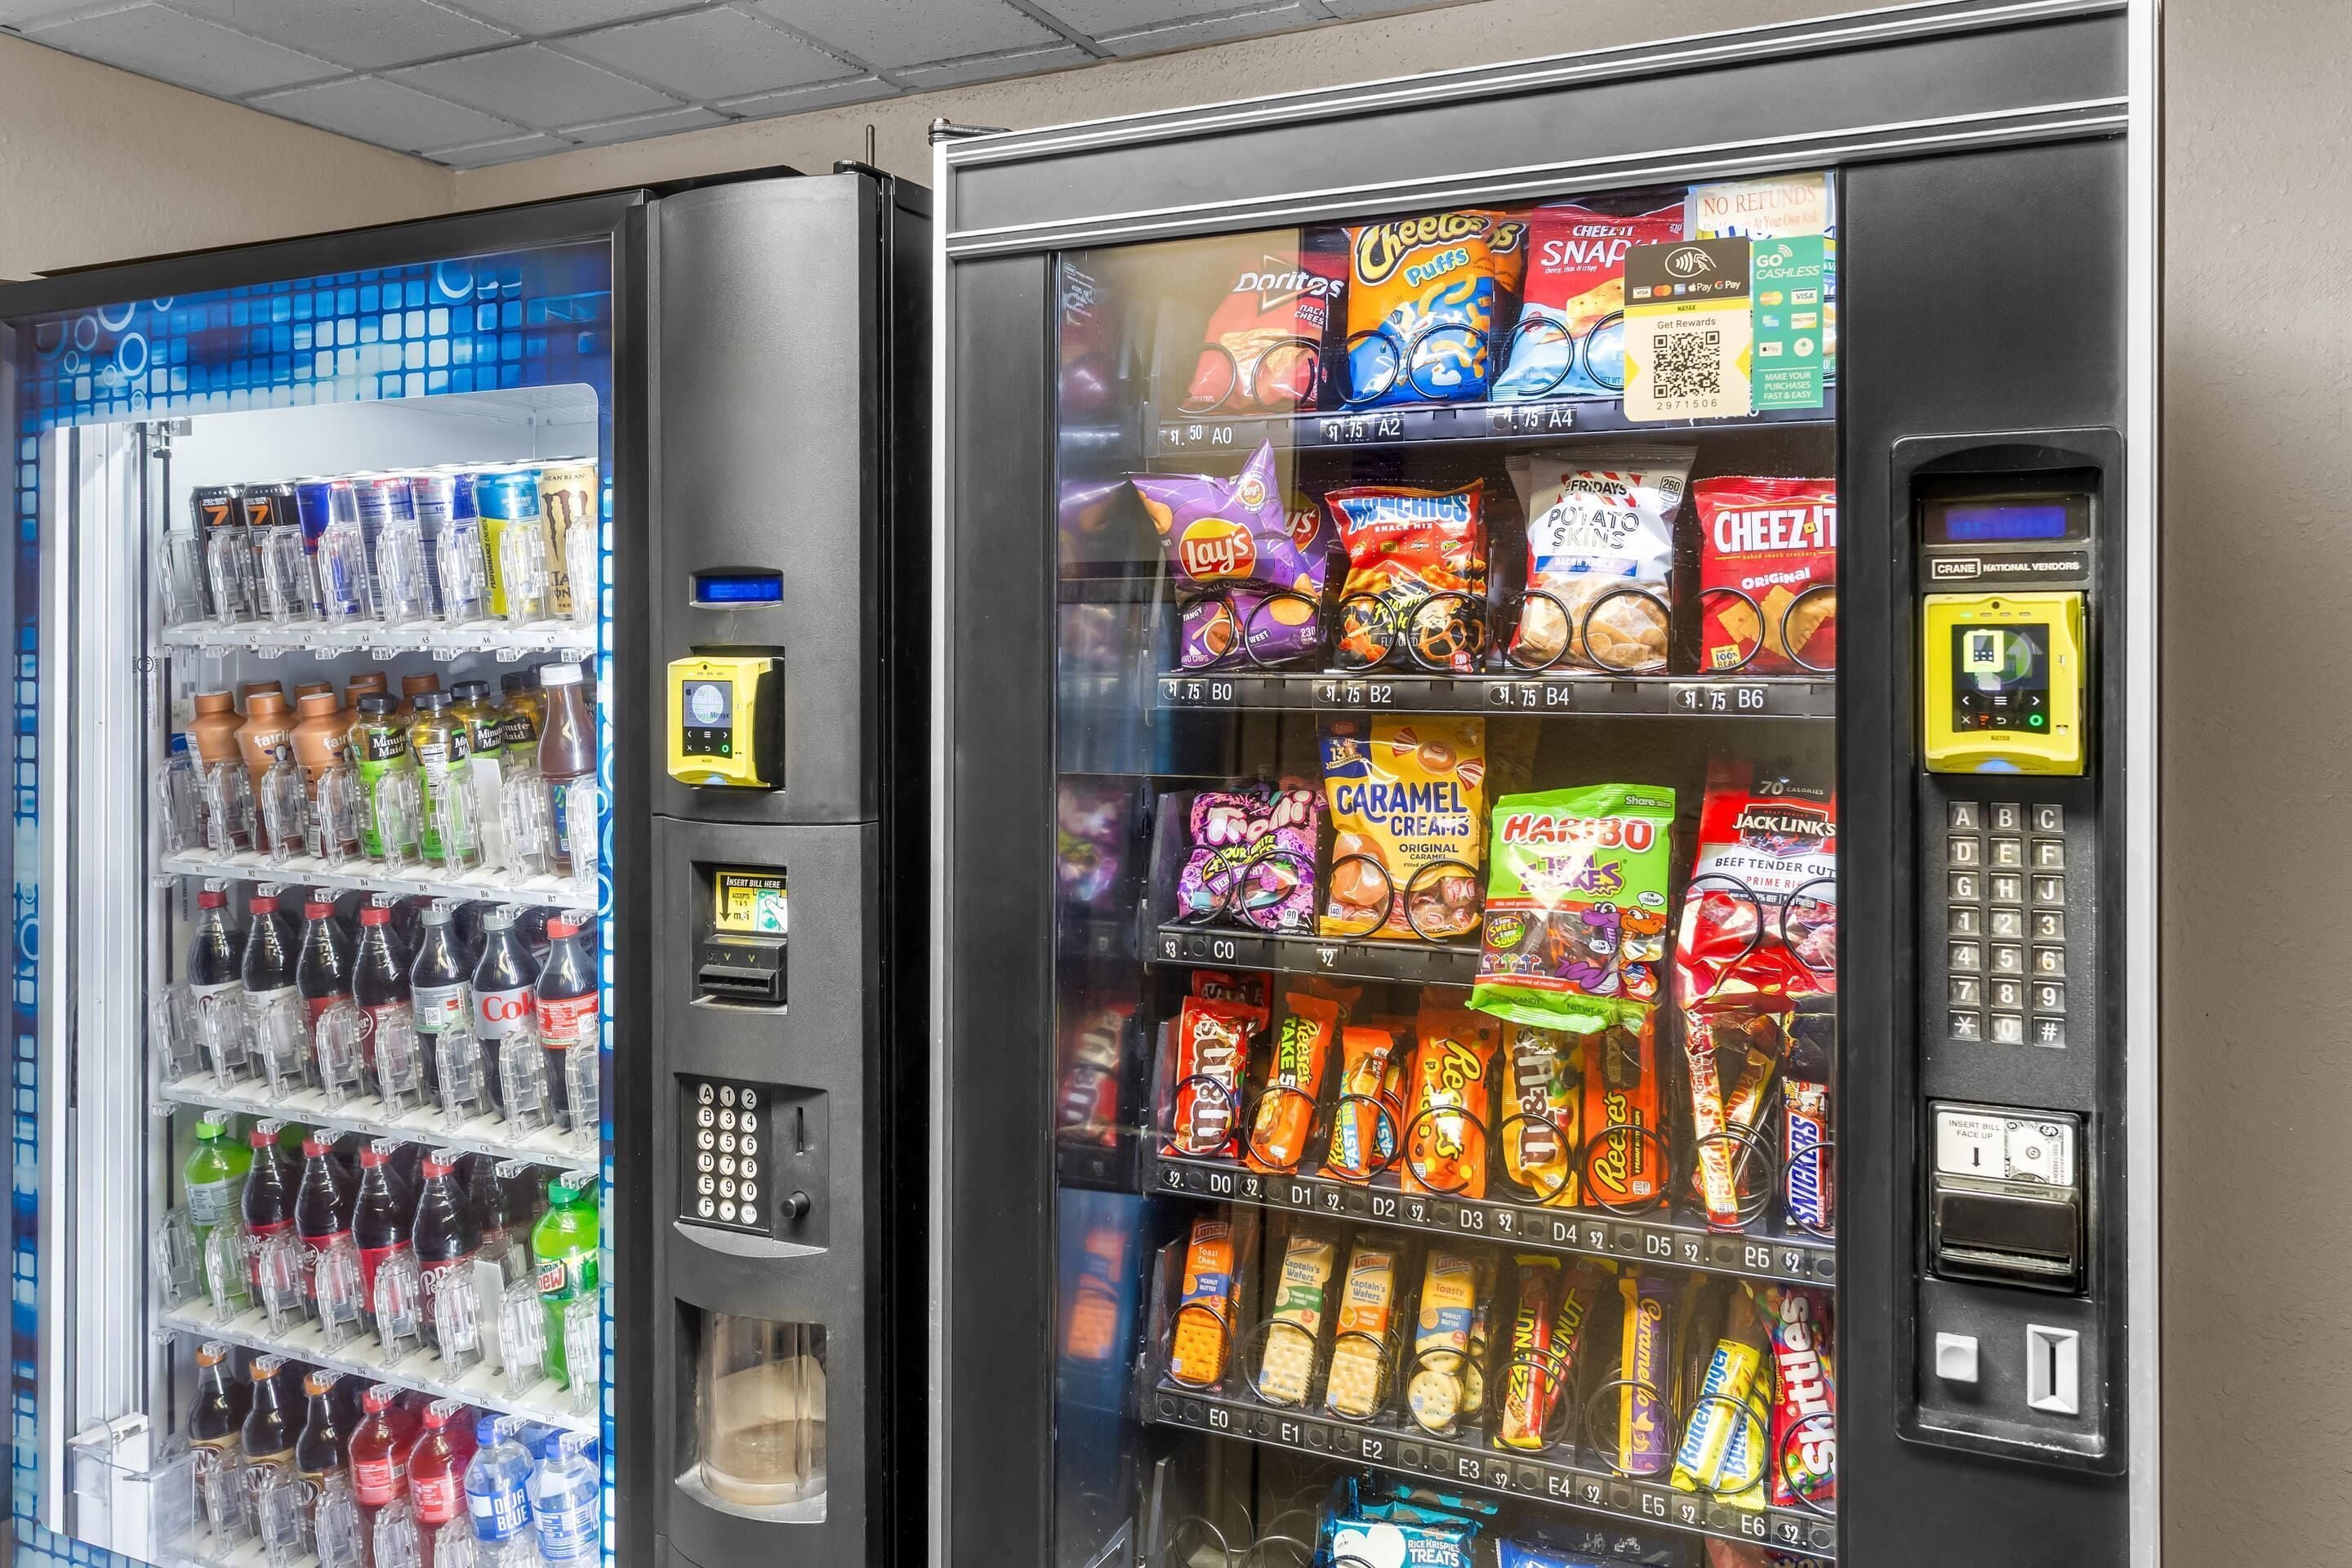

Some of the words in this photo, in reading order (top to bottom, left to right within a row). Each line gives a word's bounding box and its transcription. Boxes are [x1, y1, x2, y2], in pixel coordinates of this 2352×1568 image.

[1704, 197, 1729, 216] NO
[1736, 185, 1816, 212] REFUNDS
[1764, 216, 1782, 228] Your
[1784, 213, 1799, 226] Own
[1802, 212, 1818, 224] Risk
[1357, 214, 1486, 283] Cheetos
[1405, 247, 1469, 287] Puffs
[1756, 254, 1784, 267] GO
[1756, 265, 1820, 280] CASHLESS
[1232, 271, 1345, 298] Doritos
[1696, 283, 1712, 293] Pay
[1725, 280, 1741, 290] Pay
[1657, 321, 1673, 329] Get
[1676, 318, 1716, 327] Rewards
[1764, 372, 1788, 381] MAKE
[1788, 372, 1811, 380] YOUR
[1764, 381, 1811, 390] PURCHASES
[1763, 391, 1782, 400] FAST
[1656, 399, 1717, 410] 2971506
[1548, 408, 1573, 428] A4
[1378, 417, 1400, 437] A2
[1212, 427, 1232, 444] A0
[1570, 479, 1628, 495] FRIDAYS
[1662, 478, 1681, 489] 260
[204, 506, 229, 525] 7
[247, 506, 268, 525] 7
[1548, 506, 1640, 532] POTATO
[1374, 524, 1409, 532] SNACK
[1552, 527, 1625, 550] SKINS
[1186, 532, 1250, 574] Lay's
[1937, 564, 1976, 574] CRANE
[1983, 564, 2031, 572] NATIONAL
[2032, 562, 2079, 571] VENDORS
[1183, 606, 1203, 621] TANGY
[1300, 626, 1316, 639] 230
[1192, 653, 1209, 662] CHIPS
[1212, 683, 1232, 701] B0
[1370, 685, 1392, 703] B2
[1546, 687, 1570, 706] B4
[1738, 688, 1764, 709] B6
[373, 734, 407, 748] Minute
[378, 742, 404, 758] Maid
[1759, 781, 1784, 795] 70
[1786, 786, 1824, 795] CALORIES
[1336, 782, 1468, 823] CARAMEL
[1625, 795, 1655, 806] Share
[1207, 791, 1313, 845] Trolli
[1391, 816, 1469, 836] CREAMS
[1731, 813, 1779, 832] JACK
[1780, 816, 1836, 837] LINK'S
[1956, 808, 1971, 826] A
[1999, 809, 2012, 827] B
[2040, 809, 2055, 829] C
[1399, 844, 1459, 853] ORIGINAL
[1958, 843, 1971, 861] D
[2000, 845, 2012, 863] E
[2042, 846, 2054, 864] F
[1715, 858, 1745, 867] BEEF
[1748, 858, 1802, 873] TENDER
[726, 876, 748, 887] INSERT
[749, 880, 762, 888] BILL
[764, 880, 782, 889] HERE
[1746, 875, 1782, 888] PRIME
[1958, 878, 1971, 897] G
[2000, 880, 2013, 898] H
[2042, 881, 2055, 900] J
[419, 884, 427, 892] B5
[480, 889, 489, 898] B6
[1285, 911, 1296, 920] 90
[1959, 912, 1970, 931] 1
[2000, 915, 2012, 933] 2
[2042, 916, 2055, 935] 3
[1489, 921, 1517, 936] SWEET
[1214, 941, 1234, 960] C0
[1958, 947, 1971, 965] 4
[2001, 950, 2012, 968] 5
[2042, 951, 2056, 970] 6
[1321, 951, 1334, 967] $2
[1958, 981, 1971, 1000] 7
[2001, 985, 2013, 1003] 8
[2042, 988, 2056, 1007] 9
[2001, 1020, 2012, 1038] 0
[1281, 1016, 1296, 1070] TAKE
[703, 1088, 712, 1099] A
[746, 1093, 754, 1104] 2
[704, 1111, 712, 1121] B
[725, 1113, 733, 1124] 3
[746, 1116, 754, 1127] 4
[1949, 1120, 1980, 1129] INSERT
[1983, 1123, 2001, 1131] BILL
[704, 1133, 712, 1144] C
[725, 1135, 733, 1147] 5
[746, 1138, 754, 1150] 6
[1957, 1130, 1980, 1138] FACE
[704, 1156, 712, 1166] D
[725, 1158, 733, 1169] 7
[746, 1161, 754, 1173] 8
[1792, 1116, 1820, 1226] SNICKERS
[704, 1178, 712, 1189] E
[725, 1181, 733, 1192] 9
[746, 1184, 754, 1196] 0
[705, 1200, 712, 1212] F
[1210, 1174, 1232, 1194] D0
[1292, 1186, 1312, 1205] D1
[1373, 1197, 1396, 1218] D2
[1460, 1209, 1484, 1229] D3
[1553, 1222, 1577, 1243] D4
[1646, 1235, 1672, 1257] D5
[1198, 1246, 1218, 1257] Toast
[1285, 1258, 1321, 1274] Captain's
[1199, 1284, 1217, 1292] BUTTER
[1200, 1277, 1218, 1286] PEANUT
[1350, 1278, 1386, 1293] Captain's
[1352, 1287, 1380, 1301] Wafers
[1435, 1283, 1464, 1297] Toasty
[1441, 1318, 1460, 1327] BUTTER
[1442, 1312, 1462, 1321] PEANUT
[1637, 1298, 1663, 1407] Caramello
[1209, 1410, 1228, 1428] E0
[1281, 1424, 1299, 1443] E1
[1362, 1441, 1383, 1459] E2
[1459, 1459, 1480, 1480] E3
[1548, 1477, 1570, 1498] E4
[1642, 1494, 1665, 1517] E5
[1741, 1514, 1765, 1536] E6
[1408, 1539, 1426, 1551] RICE
[1426, 1539, 1460, 1554] KRISPIES
[1410, 1548, 1459, 1566] TREATS
